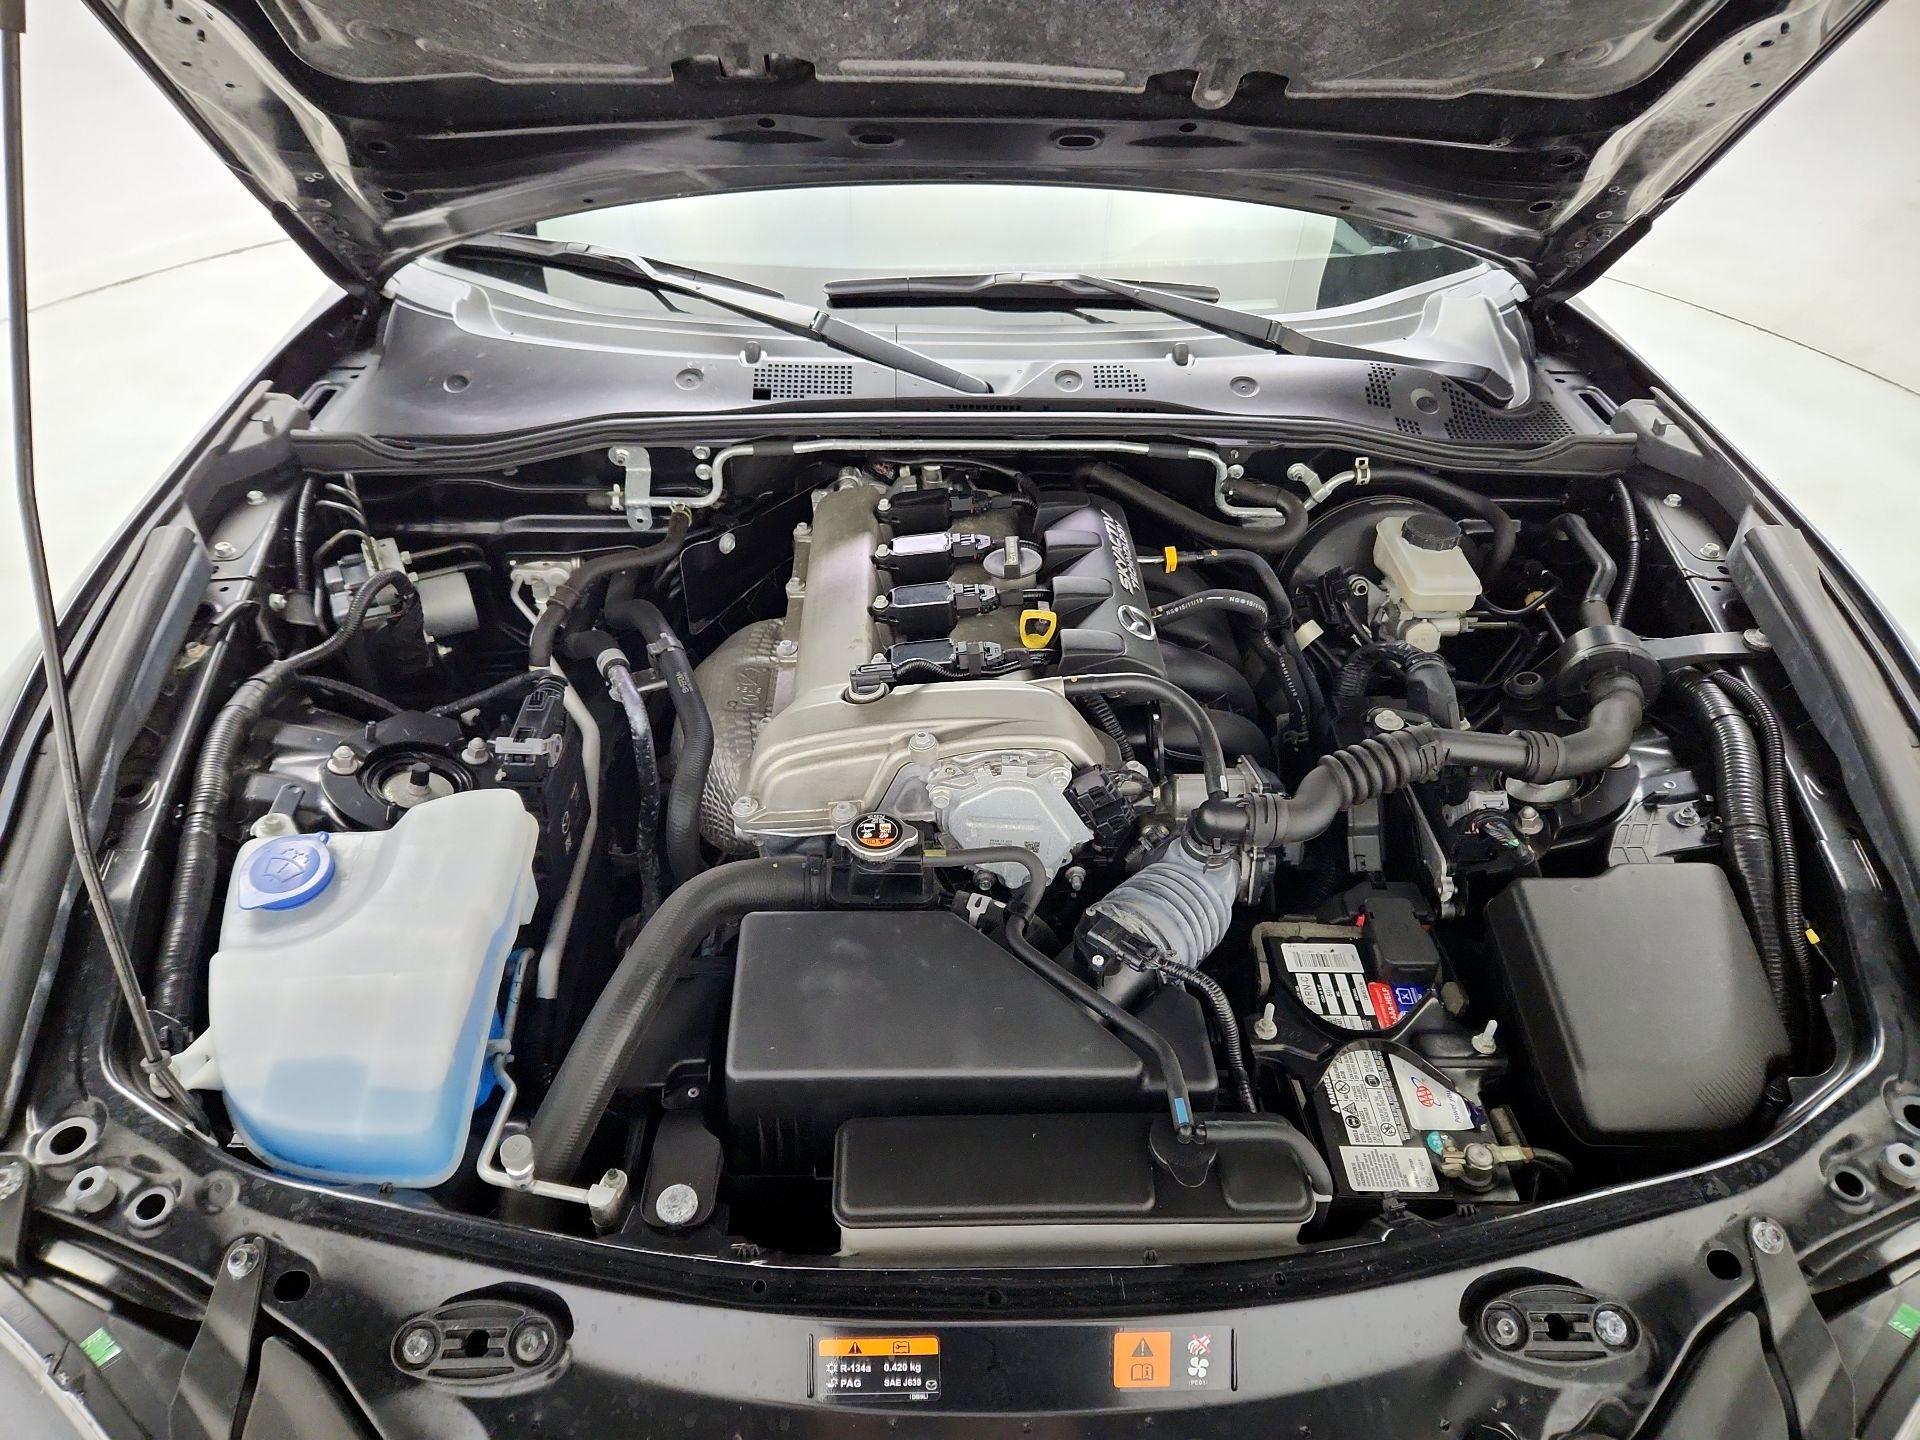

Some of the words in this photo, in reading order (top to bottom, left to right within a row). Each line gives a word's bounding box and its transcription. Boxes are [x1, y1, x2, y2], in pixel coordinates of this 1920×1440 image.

[1101, 508, 1134, 595] SKYACTIV
[1301, 976, 1317, 1006] 51RN-C
[840, 1363, 872, 1373] R-134a
[883, 1362, 908, 1372] 0.420
[909, 1362, 922, 1373] kg
[840, 1379, 862, 1388] PAG
[883, 1379, 902, 1387] SAE
[902, 1379, 922, 1387] J639
